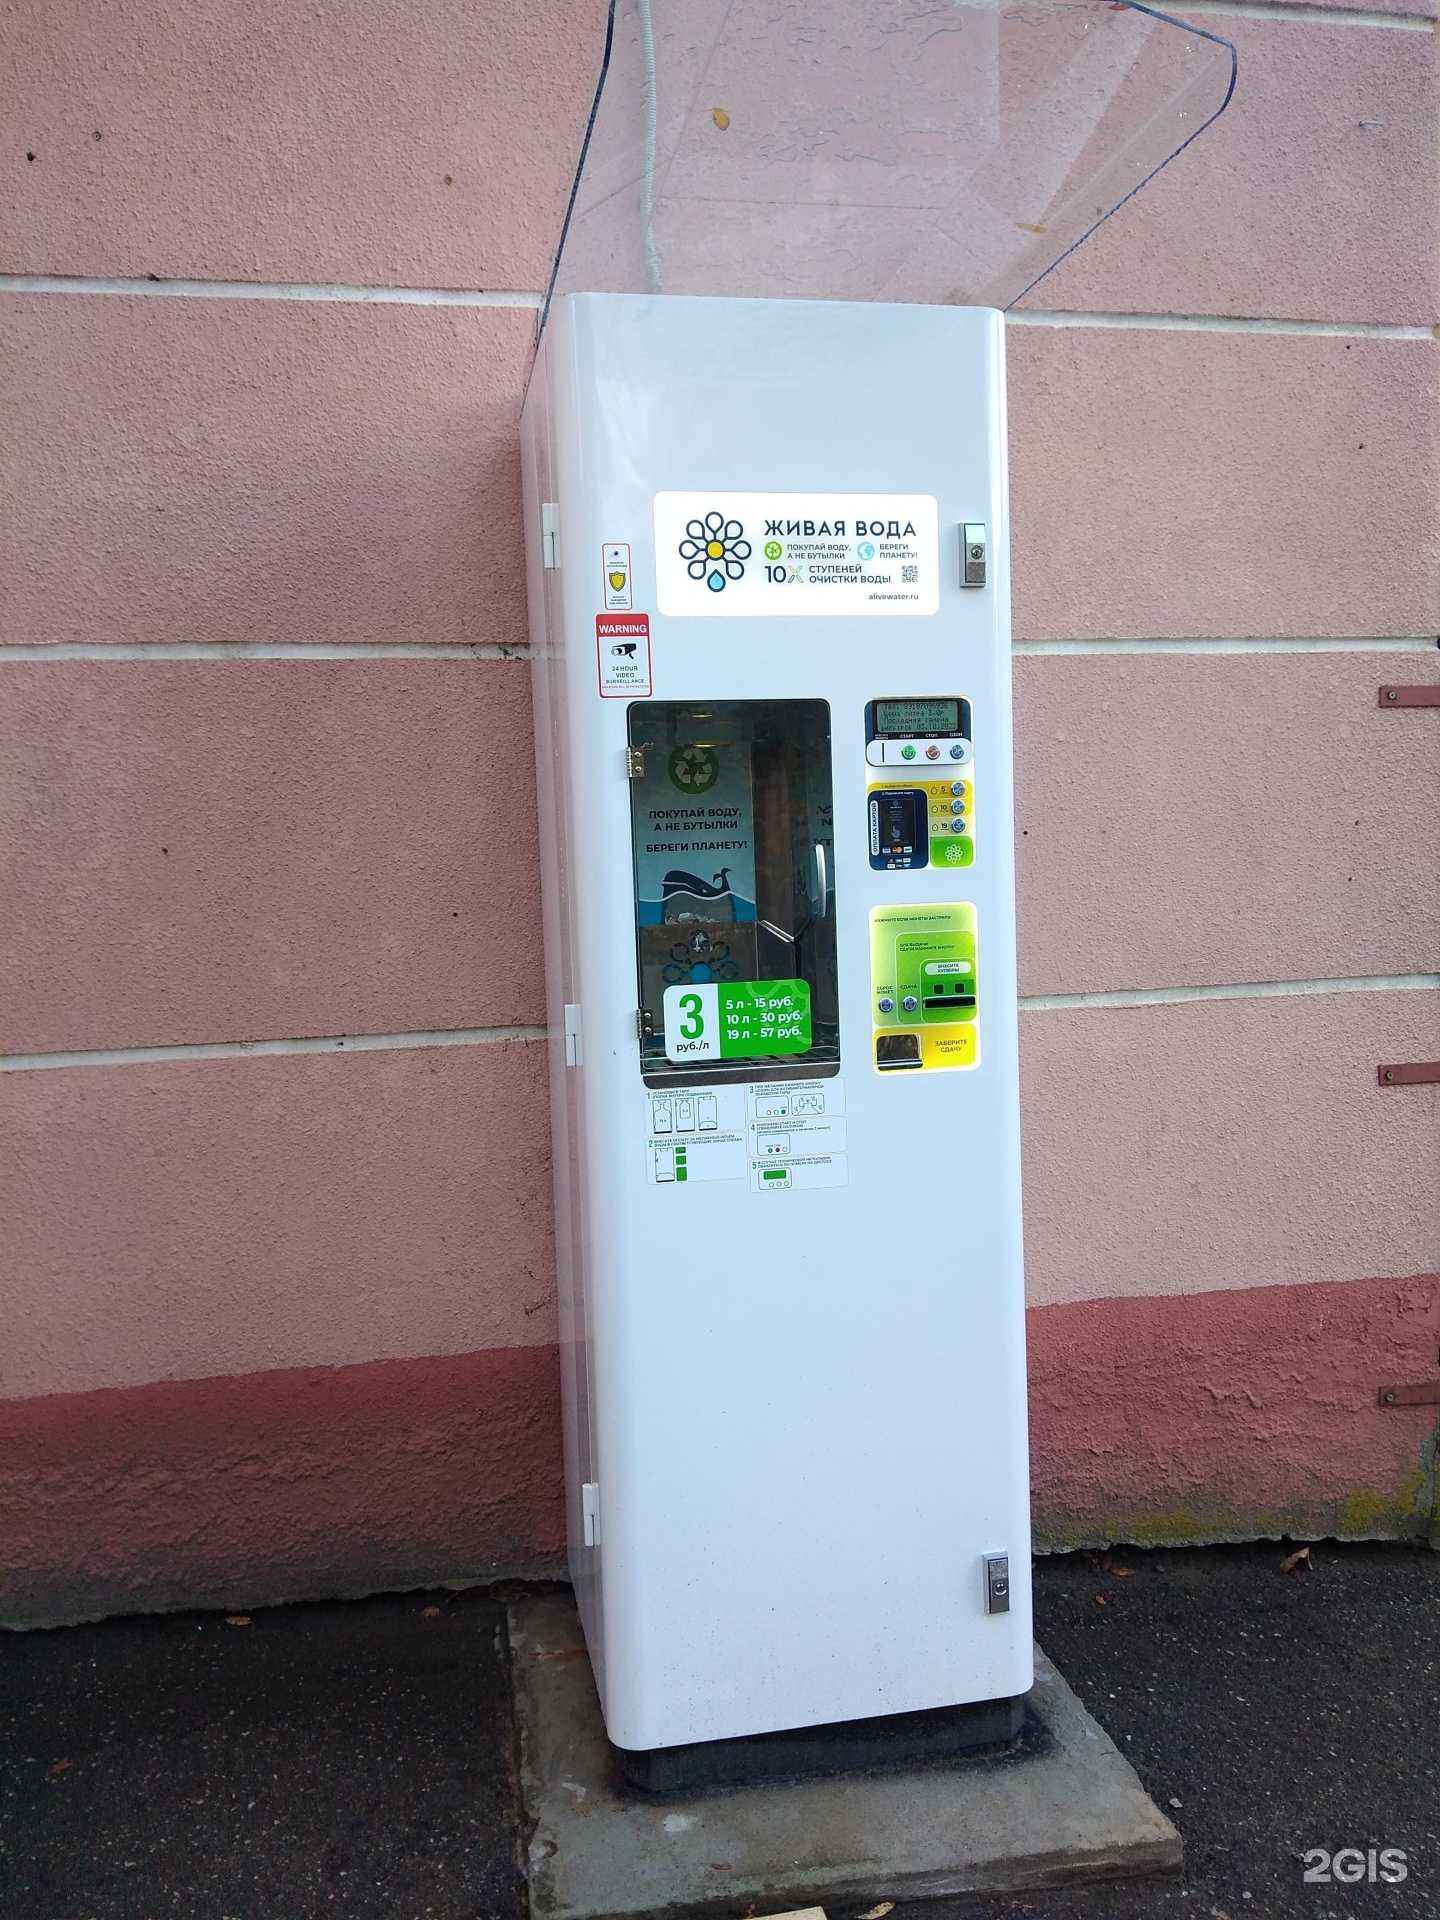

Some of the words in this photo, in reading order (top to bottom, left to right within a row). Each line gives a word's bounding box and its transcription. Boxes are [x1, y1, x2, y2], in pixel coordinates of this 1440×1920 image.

[764, 519, 846, 537] ЖИВАЯ
[855, 520, 917, 539] ВОДА
[787, 543, 826, 551] ПОКУПАЙ
[827, 543, 851, 552] ВОДУ,
[879, 543, 909, 551] БЕРЕГИ
[807, 552, 846, 560] БУТЫЛКИ
[879, 552, 918, 560] ПЛАНЕТУ!
[809, 564, 863, 574] СТУПЕНЕЙ
[809, 575, 858, 584] ОЧИСТКИ
[860, 575, 891, 585] ВОДЫ
[598, 624, 648, 634] WARNING
[649, 807, 705, 819] ПОКУПАЙ
[708, 807, 742, 818] ВОДУ,
[654, 823, 662, 831] А
[665, 822, 681, 831] НЕ
[683, 820, 738, 831] БУТЫЛКИ
[646, 843, 689, 853] БЕРЕГИ
[691, 840, 748, 851] ПЛАНЕТУ!
[726, 1000, 734, 1010] 5
[735, 1001, 744, 1009] л
[754, 998, 766, 1008] 15
[769, 996, 794, 1011] руб.
[678, 993, 705, 1040] 3
[726, 1015, 739, 1025] 10
[741, 1016, 750, 1024] л
[759, 1012, 775, 1022] 30
[778, 1010, 803, 1025] руб.
[726, 1029, 740, 1039] 19
[741, 1030, 750, 1039] л
[760, 1027, 774, 1038] 57
[777, 1025, 802, 1040] руб.
[676, 1039, 709, 1053] руб./л
[749, 1085, 754, 1094] 3
[648, 1139, 653, 1148] 2
[752, 1161, 757, 1170] 5
